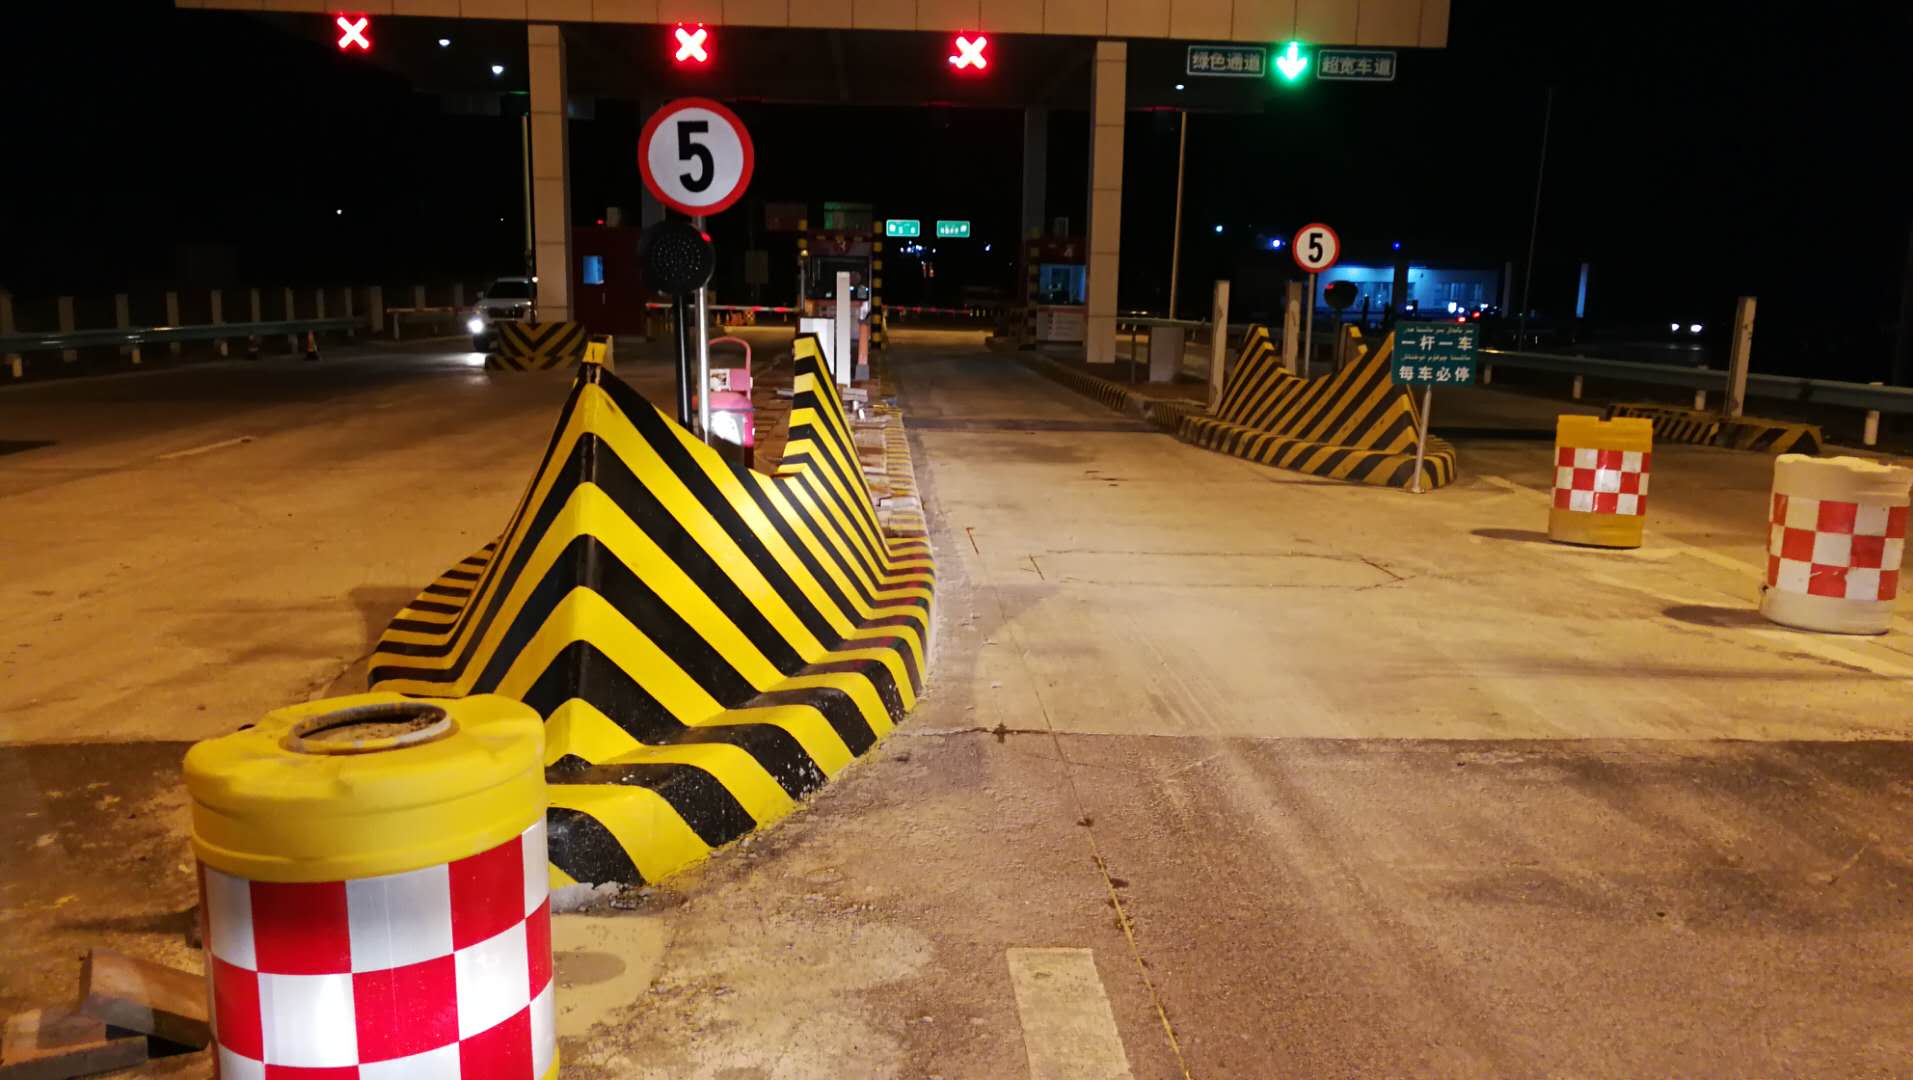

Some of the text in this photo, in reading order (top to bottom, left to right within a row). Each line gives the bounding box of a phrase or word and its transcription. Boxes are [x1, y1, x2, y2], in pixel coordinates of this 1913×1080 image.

[677, 120, 715, 193] 5
[1308, 232, 1324, 264] 5
[1401, 335, 1473, 351] 一杆一车
[1399, 366, 1470, 382] 每车必停
